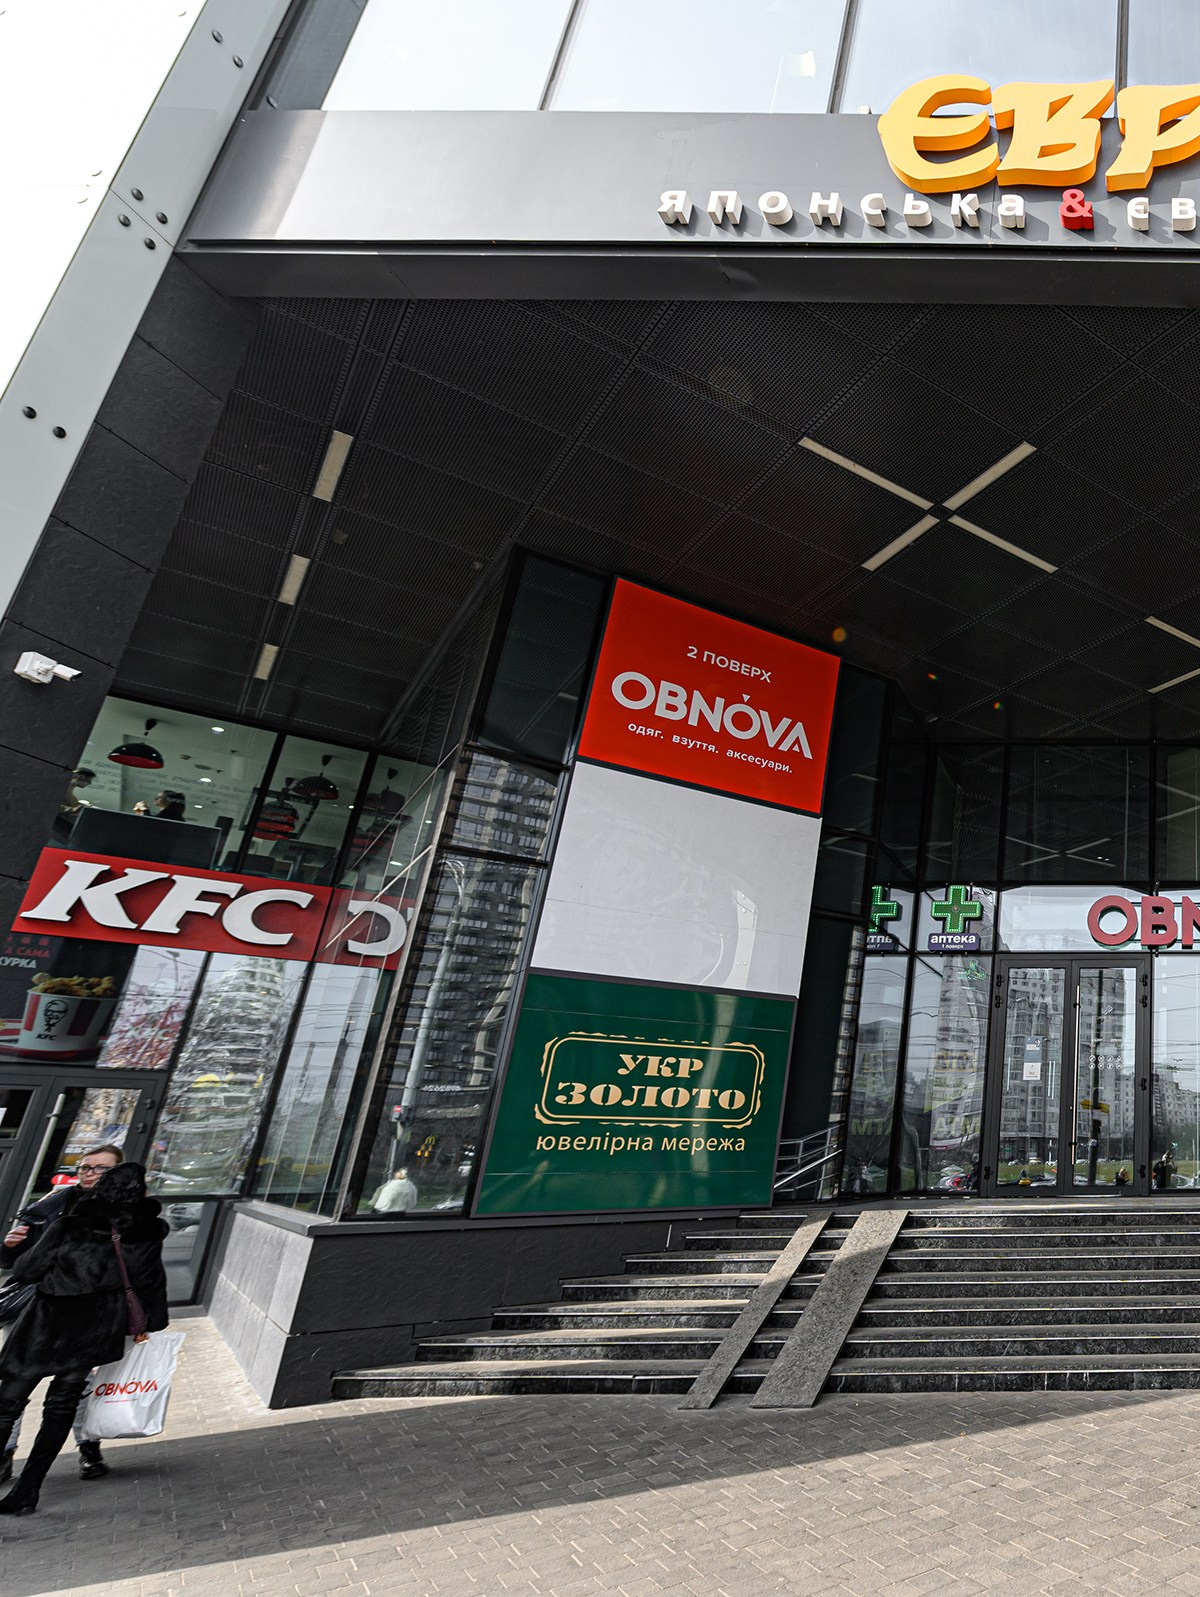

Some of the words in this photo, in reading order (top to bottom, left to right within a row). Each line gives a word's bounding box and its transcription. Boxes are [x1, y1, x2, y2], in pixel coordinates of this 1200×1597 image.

[1059, 187, 1094, 231] &
[686, 645, 698, 660] 2
[702, 650, 773, 684] ПОВЕРХ
[627, 722, 665, 740] одяг.
[671, 735, 719, 755] взуття.
[725, 749, 793, 774] аксесуари.
[20, 860, 315, 946] KFC
[930, 935, 977, 944] аптека
[617, 1054, 704, 1078] УКР
[555, 1082, 746, 1110] ЗОЛОТО
[535, 1131, 653, 1155] ювелірна
[661, 1136, 746, 1156] мережа
